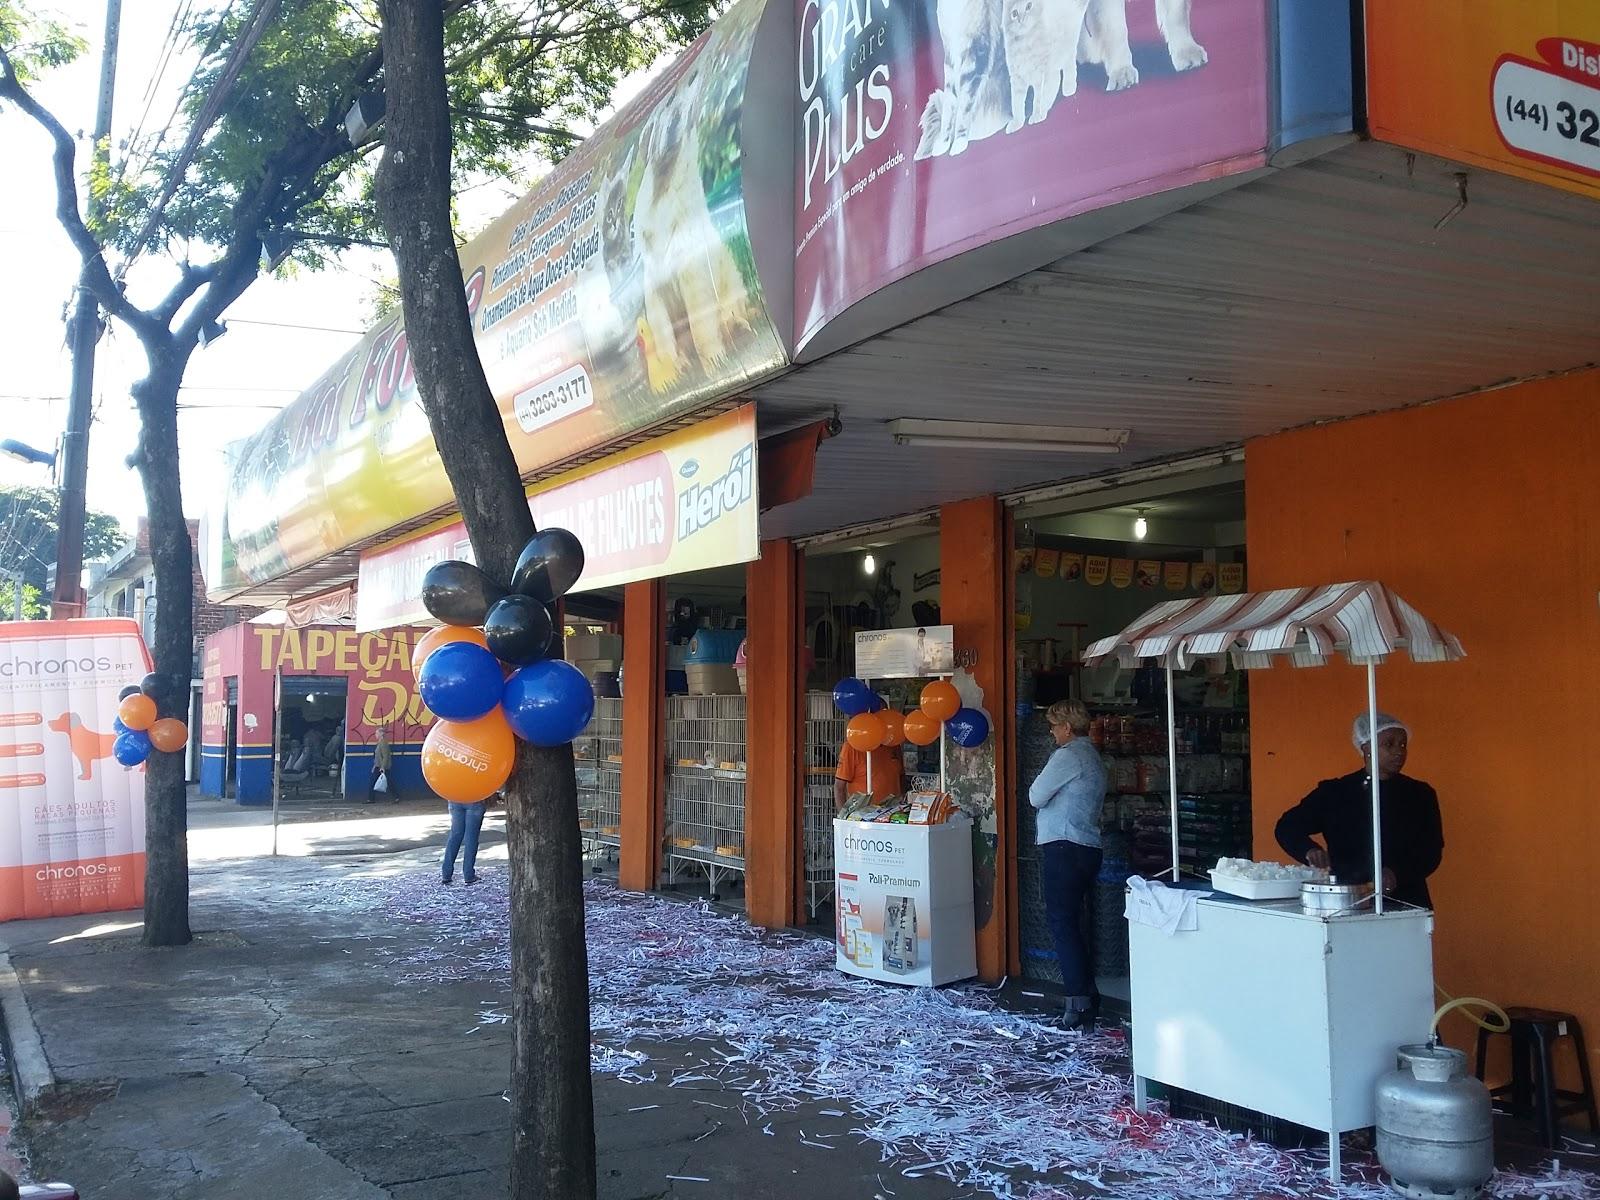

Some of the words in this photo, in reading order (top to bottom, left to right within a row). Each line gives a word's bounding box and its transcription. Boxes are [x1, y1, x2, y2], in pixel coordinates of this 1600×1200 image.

[1506, 96, 1549, 131] (44)
[803, 64, 893, 211] PLUS
[850, 179, 868, 196] amigo
[867, 167, 876, 182] de
[569, 193, 598, 234] Peixes
[482, 288, 518, 332] Ornamentais
[519, 279, 527, 306] de
[545, 256, 563, 288] Doce
[678, 442, 754, 542] Herói
[599, 476, 665, 556] FILHOTES
[857, 632, 888, 643] chronos
[0, 656, 111, 677] chronos
[115, 663, 133, 671] PET
[438, 745, 489, 773] chronos
[844, 833, 893, 853] chronos
[36, 863, 107, 881] chronos
[108, 865, 121, 873] PET
